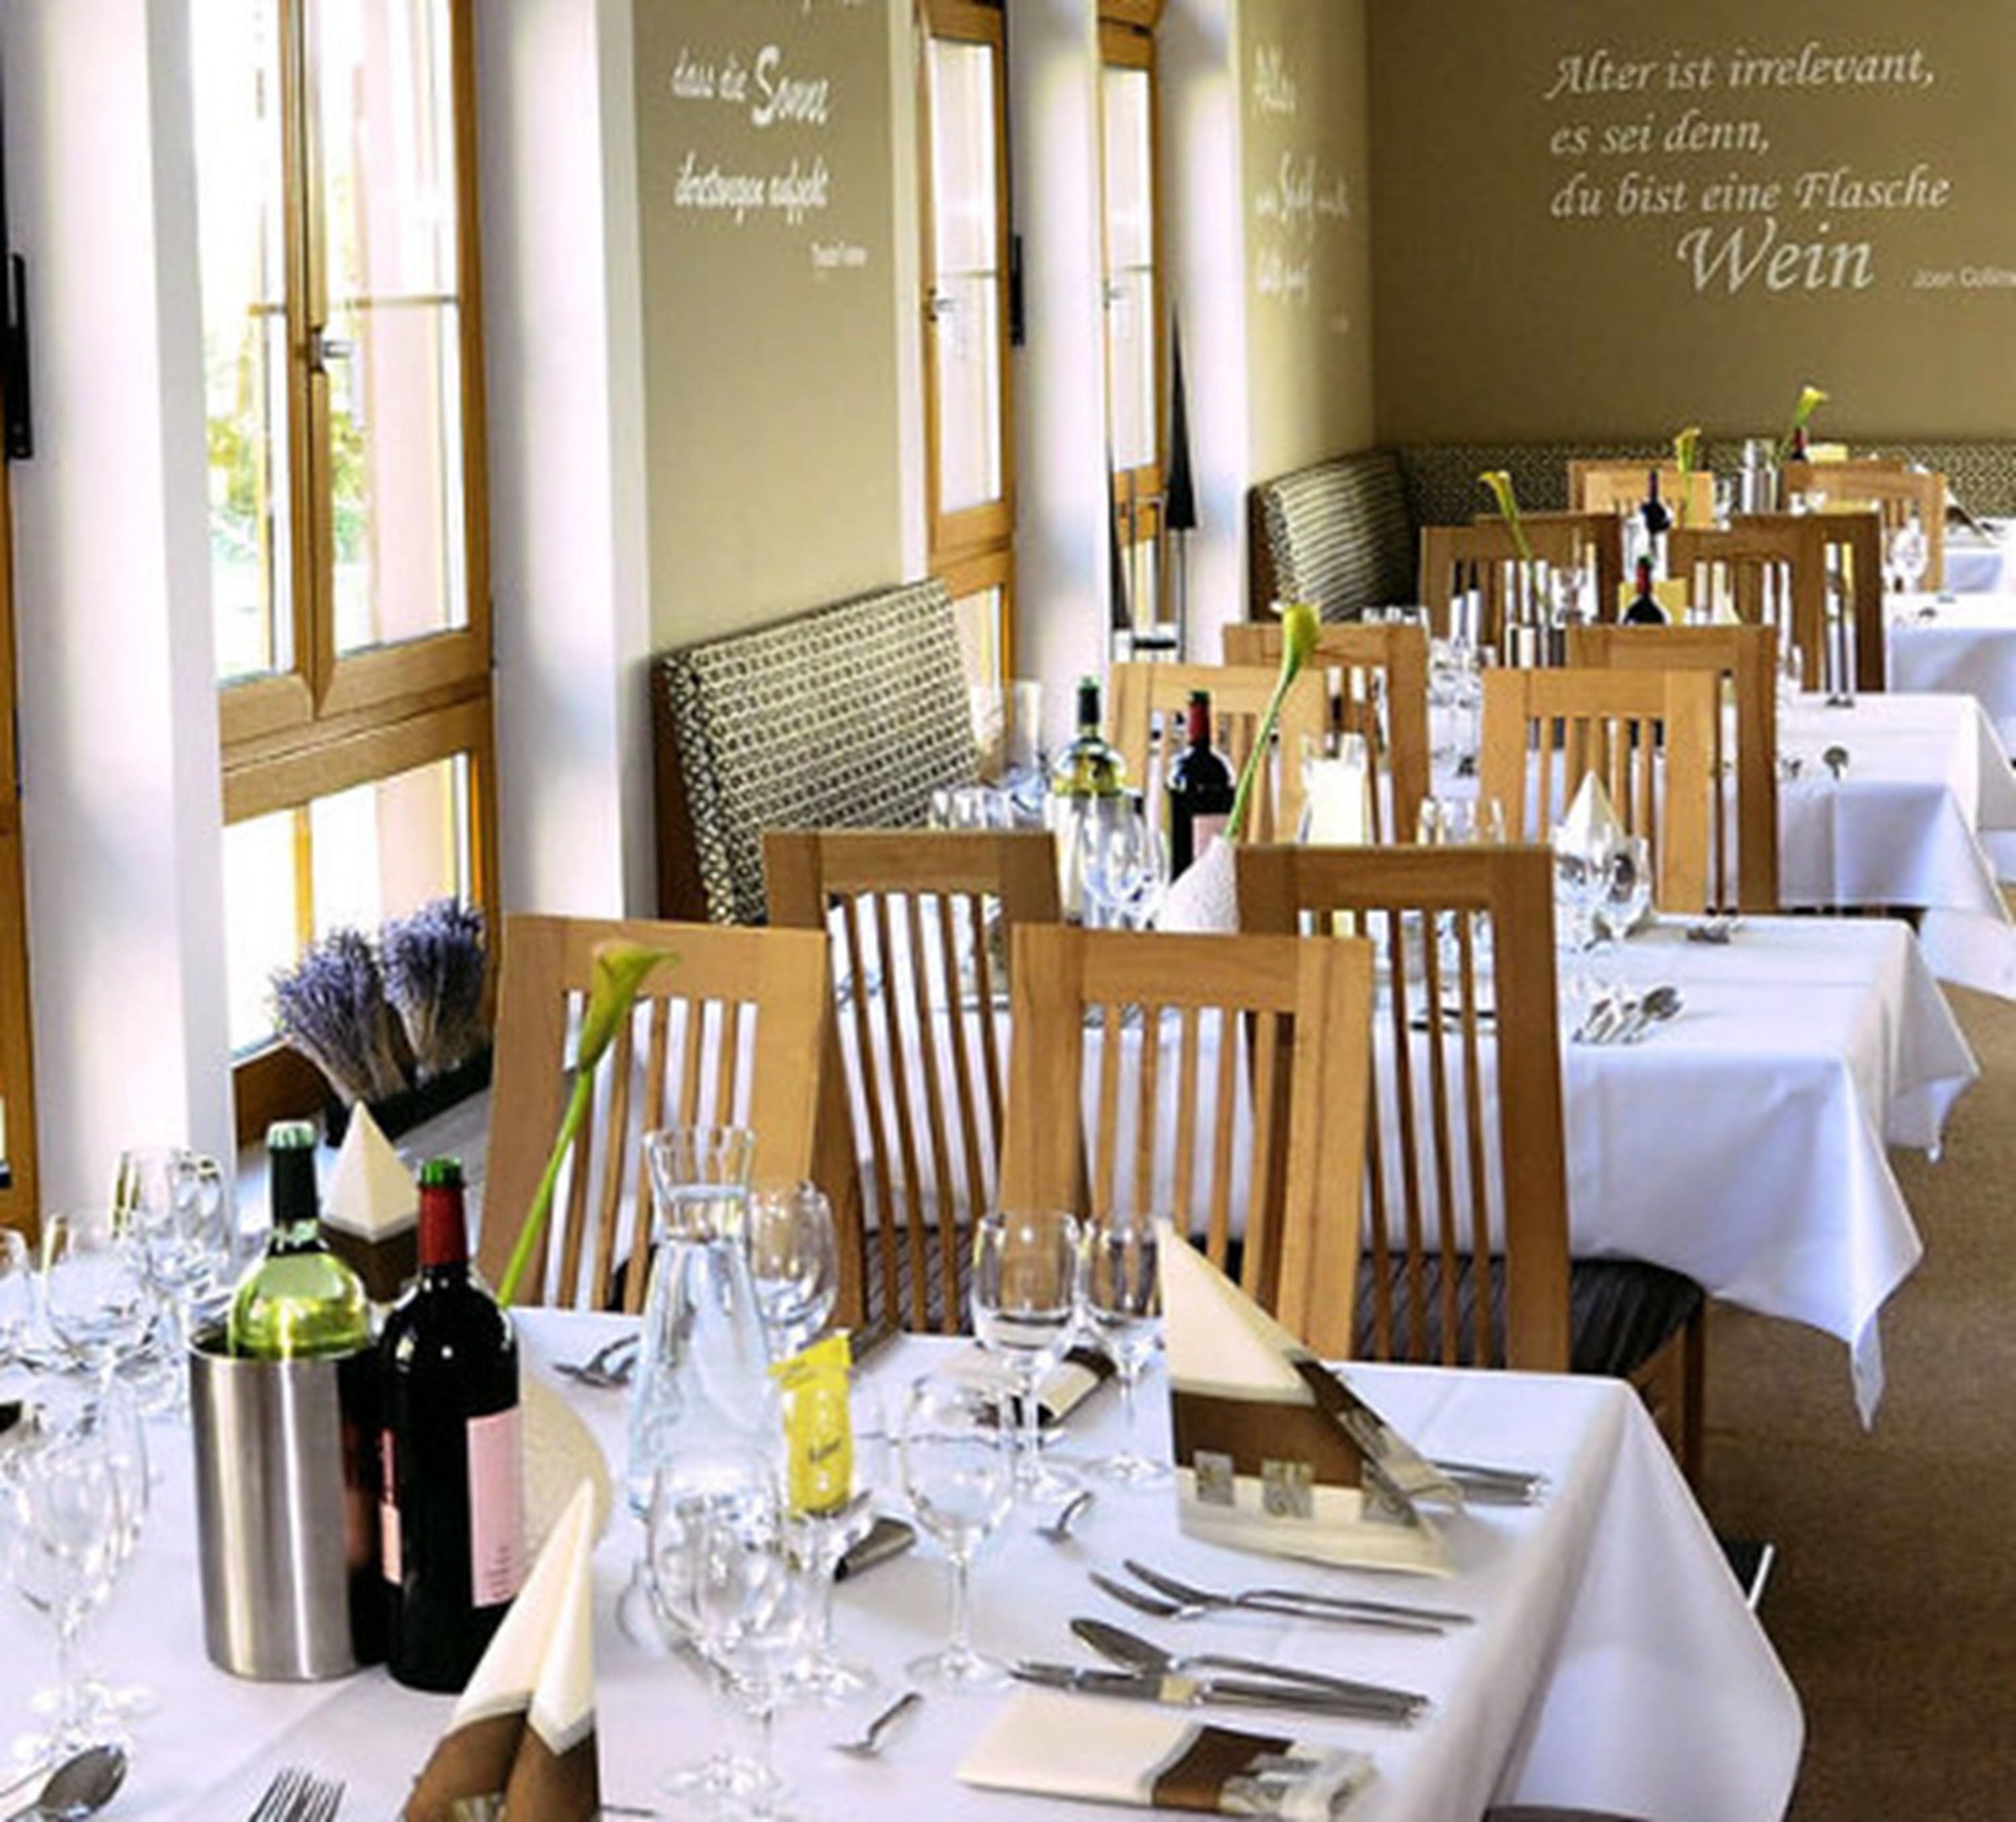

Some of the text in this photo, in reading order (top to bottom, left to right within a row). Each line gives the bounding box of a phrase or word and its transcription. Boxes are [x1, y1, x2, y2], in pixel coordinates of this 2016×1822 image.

[1545, 42, 1937, 99] Alter ist irrelevant,
[1550, 109, 1770, 155] es sei denn,
[1550, 165, 1950, 218] du bist eine Flasche
[1676, 216, 1874, 294] Wein
